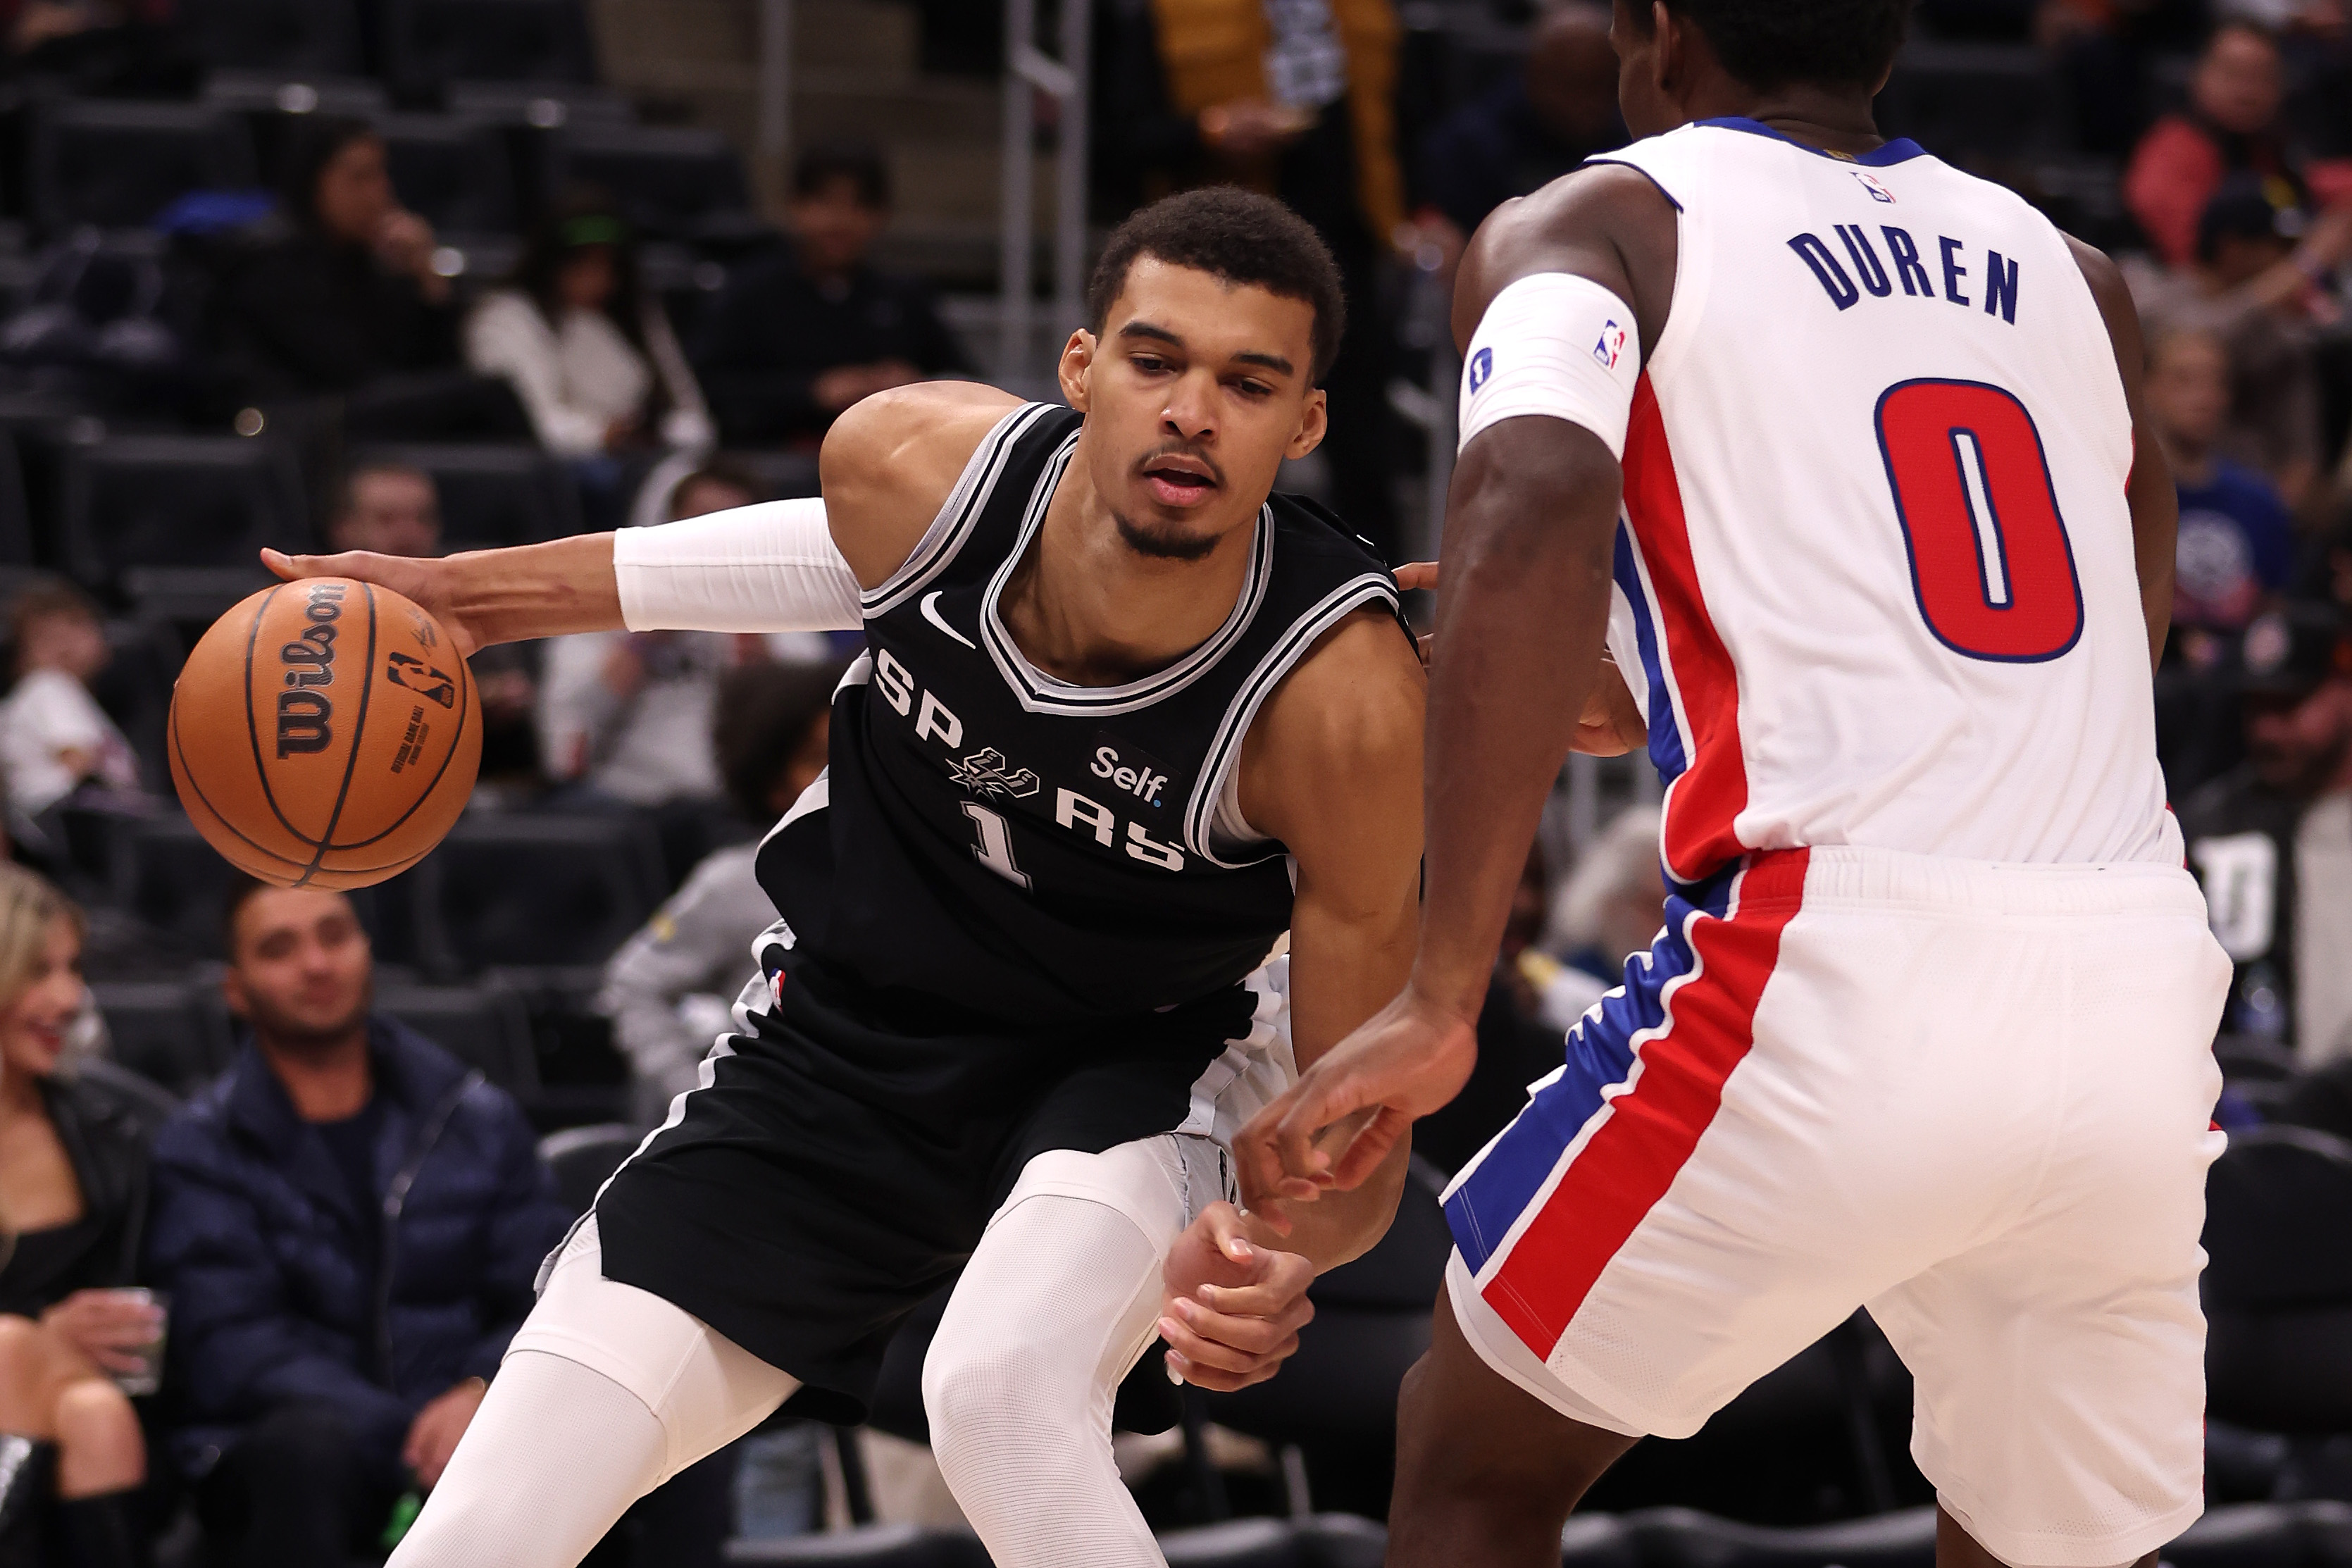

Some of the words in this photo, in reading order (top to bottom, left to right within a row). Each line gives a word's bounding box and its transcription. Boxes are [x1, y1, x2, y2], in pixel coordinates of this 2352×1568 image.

[1786, 224, 2019, 325] DUREN
[1874, 378, 2084, 663] 0
[277, 584, 348, 760] Wilson
[959, 800, 1033, 894] 1
